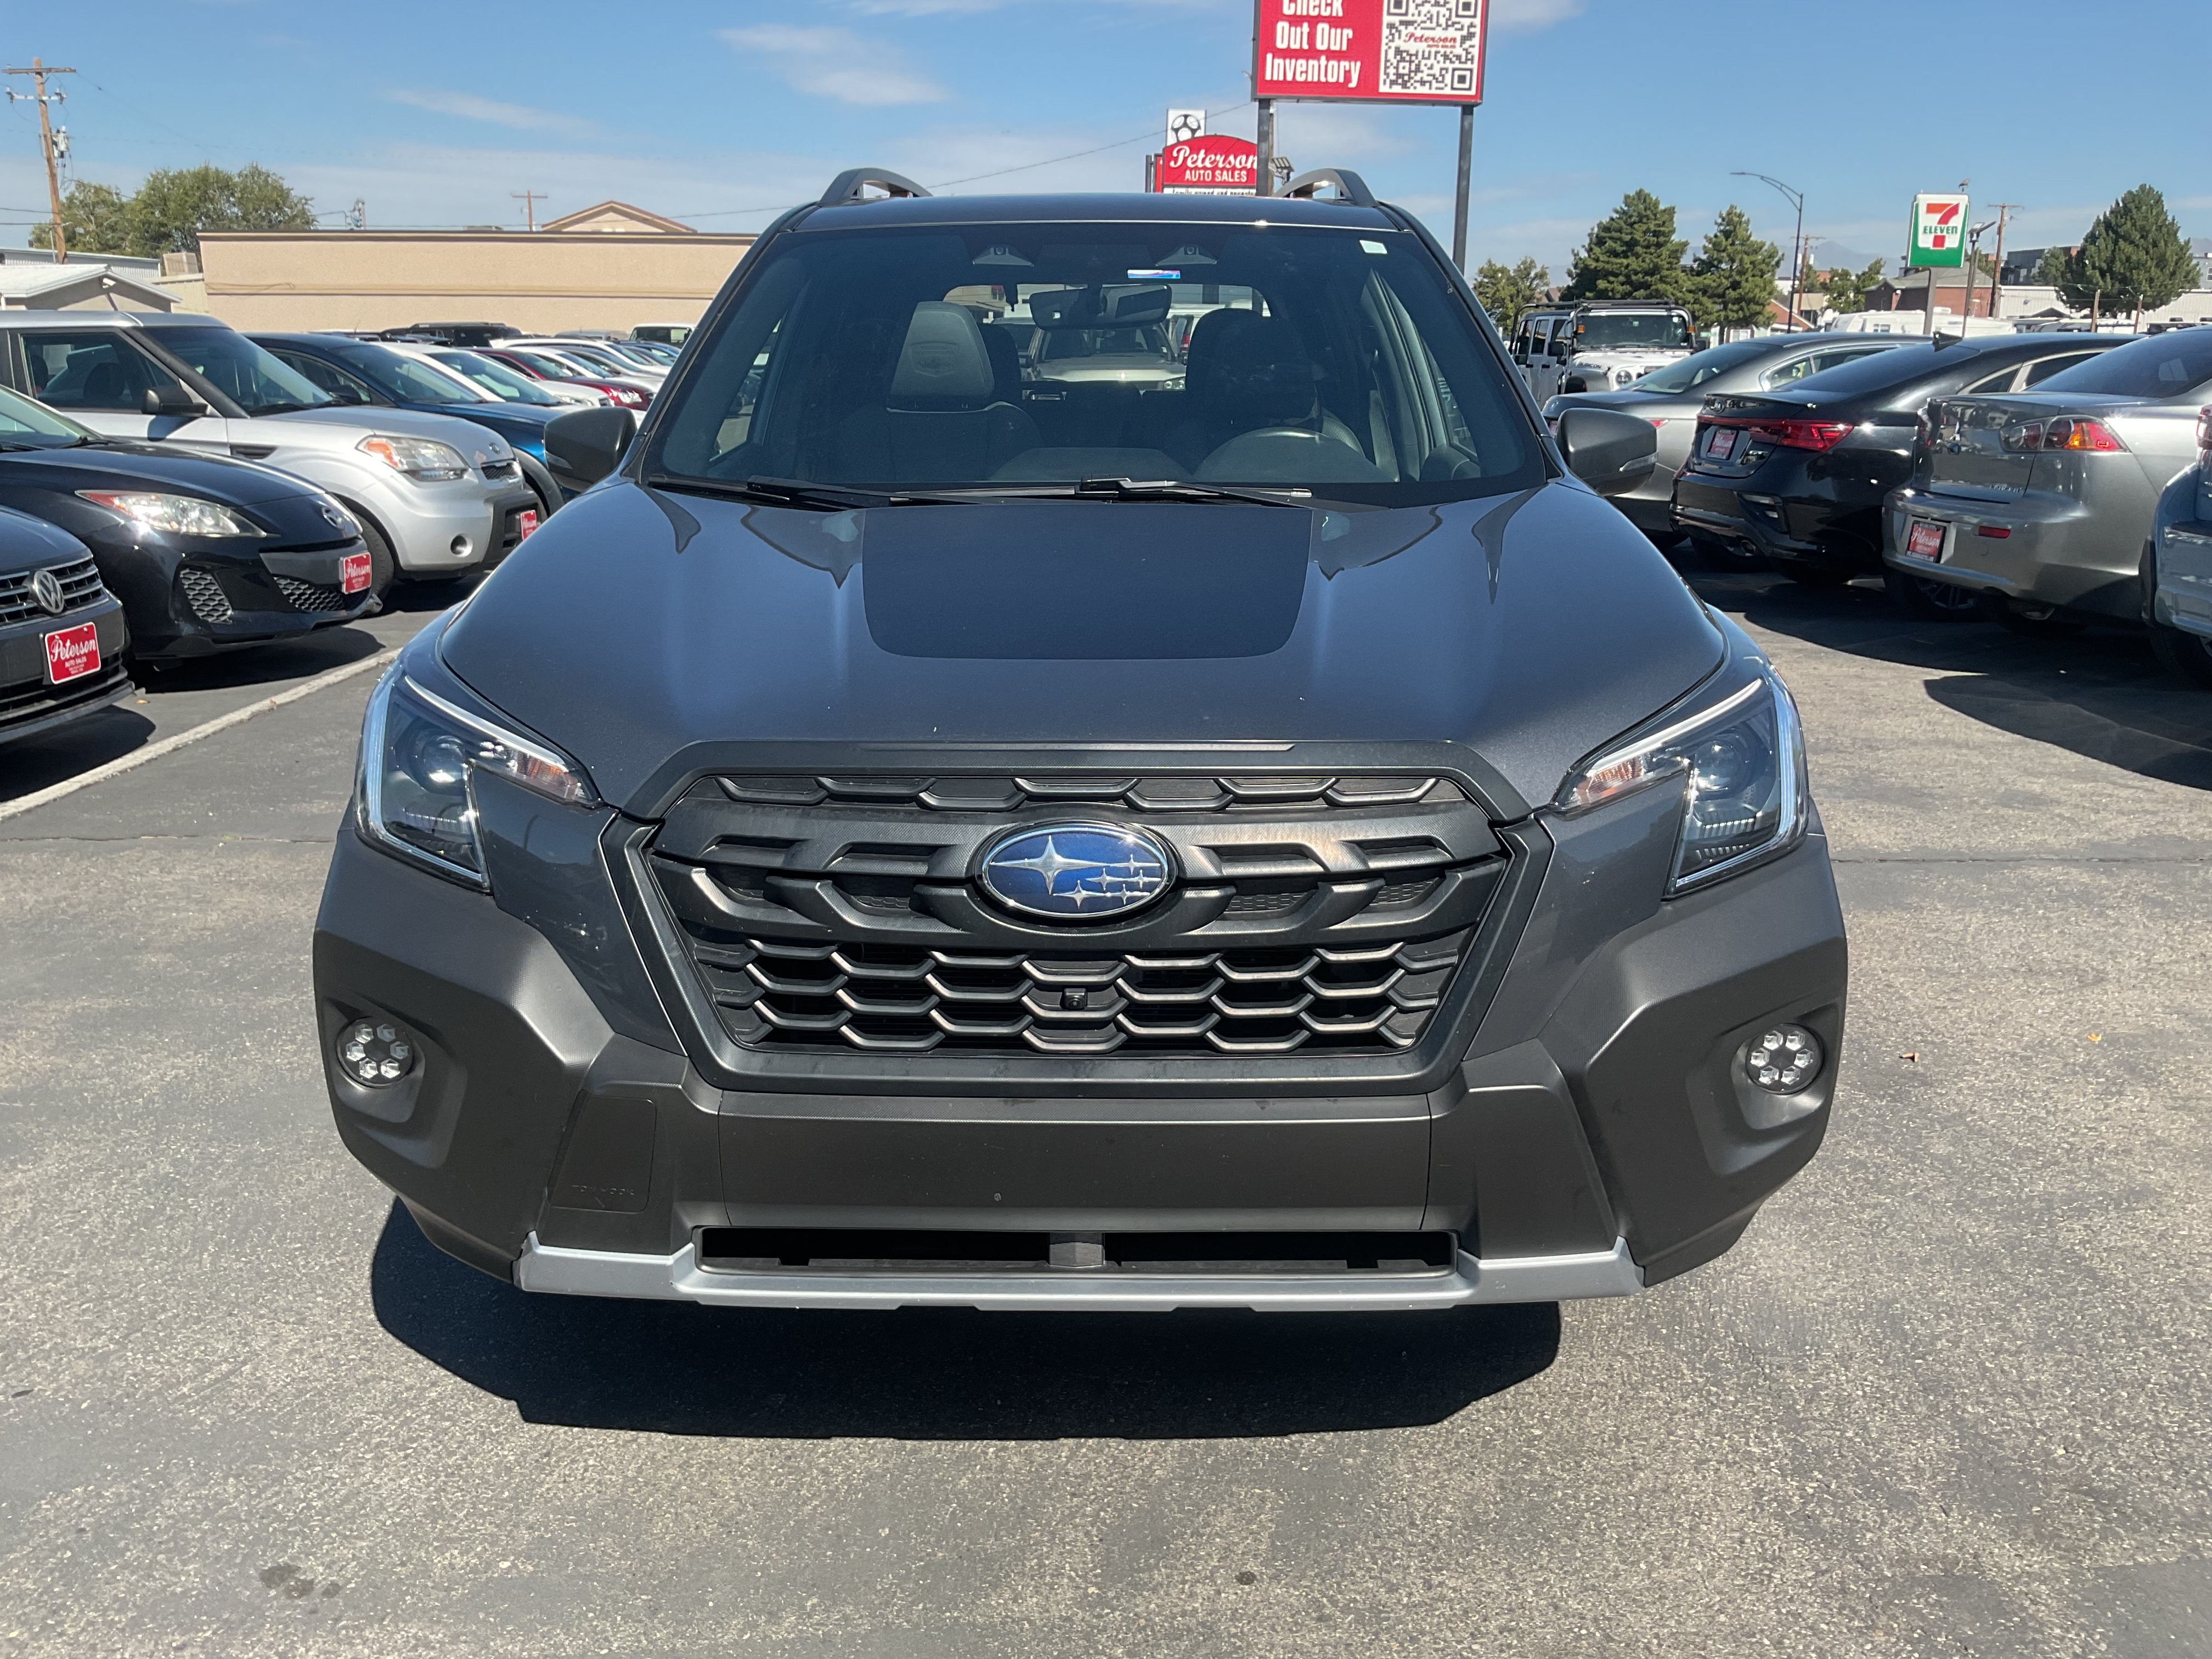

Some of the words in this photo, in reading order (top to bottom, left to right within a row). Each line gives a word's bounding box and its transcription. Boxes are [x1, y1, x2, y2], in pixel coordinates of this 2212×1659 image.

[1276, 21, 1310, 49] Out
[1316, 22, 1353, 50] Our
[1404, 32, 1457, 43] Peterson
[1265, 53, 1361, 88] Inventory
[1170, 145, 1257, 169] Peterson
[1185, 170, 1212, 182] AUTO
[1215, 171, 1247, 182] SALES
[1926, 203, 1960, 248] 7
[1911, 527, 1940, 548] Peterson
[51, 639, 96, 662] Peterson
